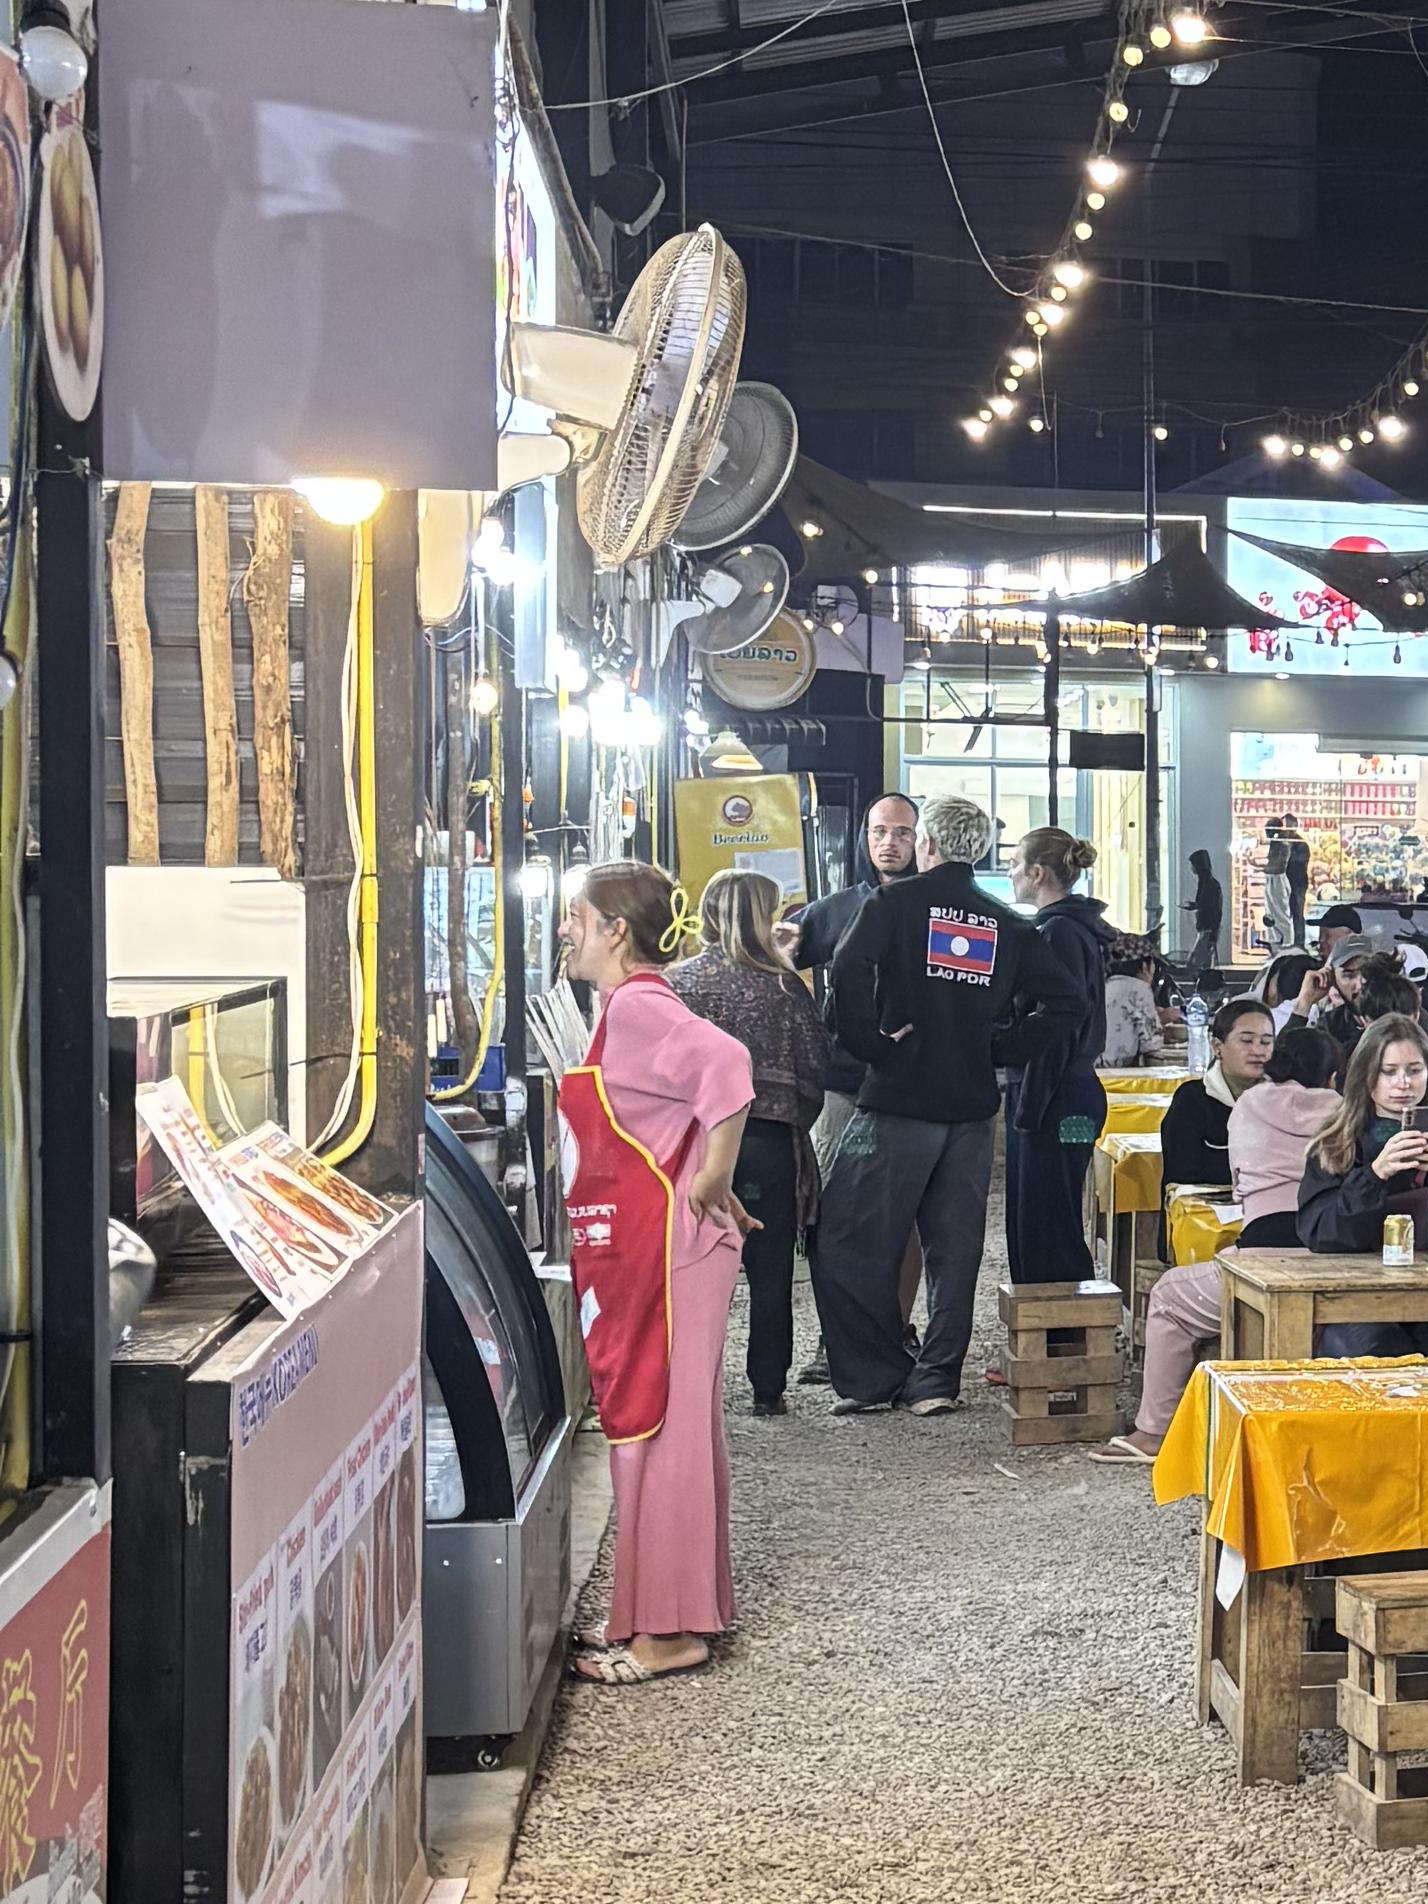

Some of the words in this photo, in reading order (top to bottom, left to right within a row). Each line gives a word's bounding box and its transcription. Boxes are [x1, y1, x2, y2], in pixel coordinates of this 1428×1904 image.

[967, 913, 998, 928] ລາວ
[926, 966, 954, 980] LAO
[956, 971, 991, 987] PDR
